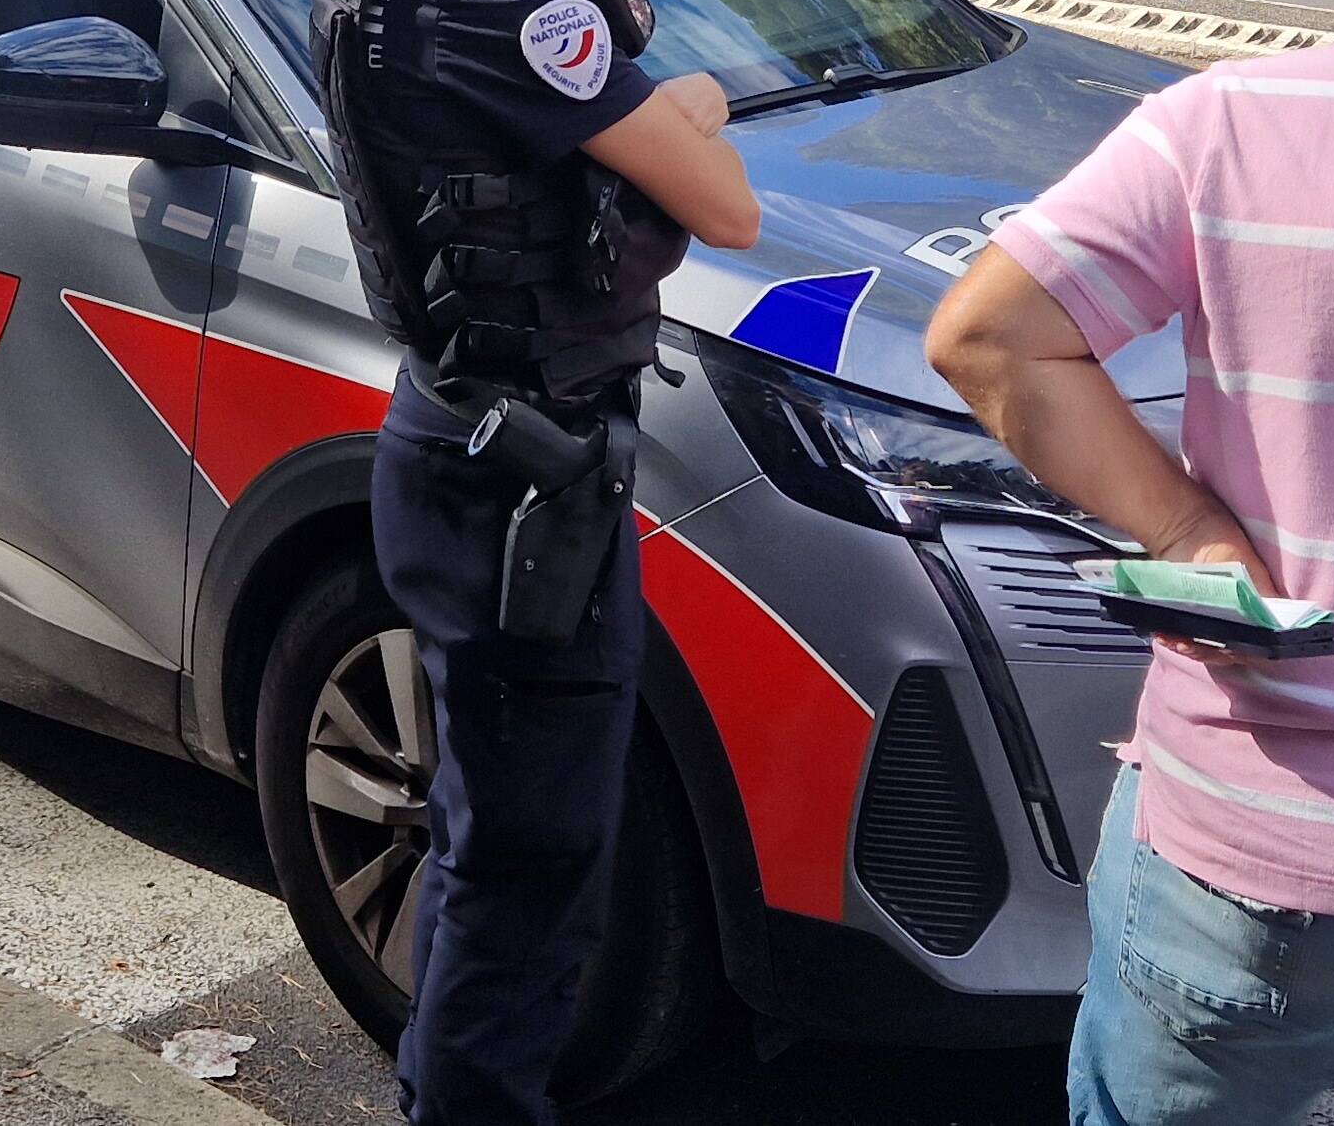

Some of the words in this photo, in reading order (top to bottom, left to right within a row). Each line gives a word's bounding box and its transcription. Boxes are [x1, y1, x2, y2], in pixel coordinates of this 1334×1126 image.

[530, 13, 597, 45] NATIONALE
[538, 6, 580, 29] POLICE
[587, 42, 605, 90] PUBLIQUE
